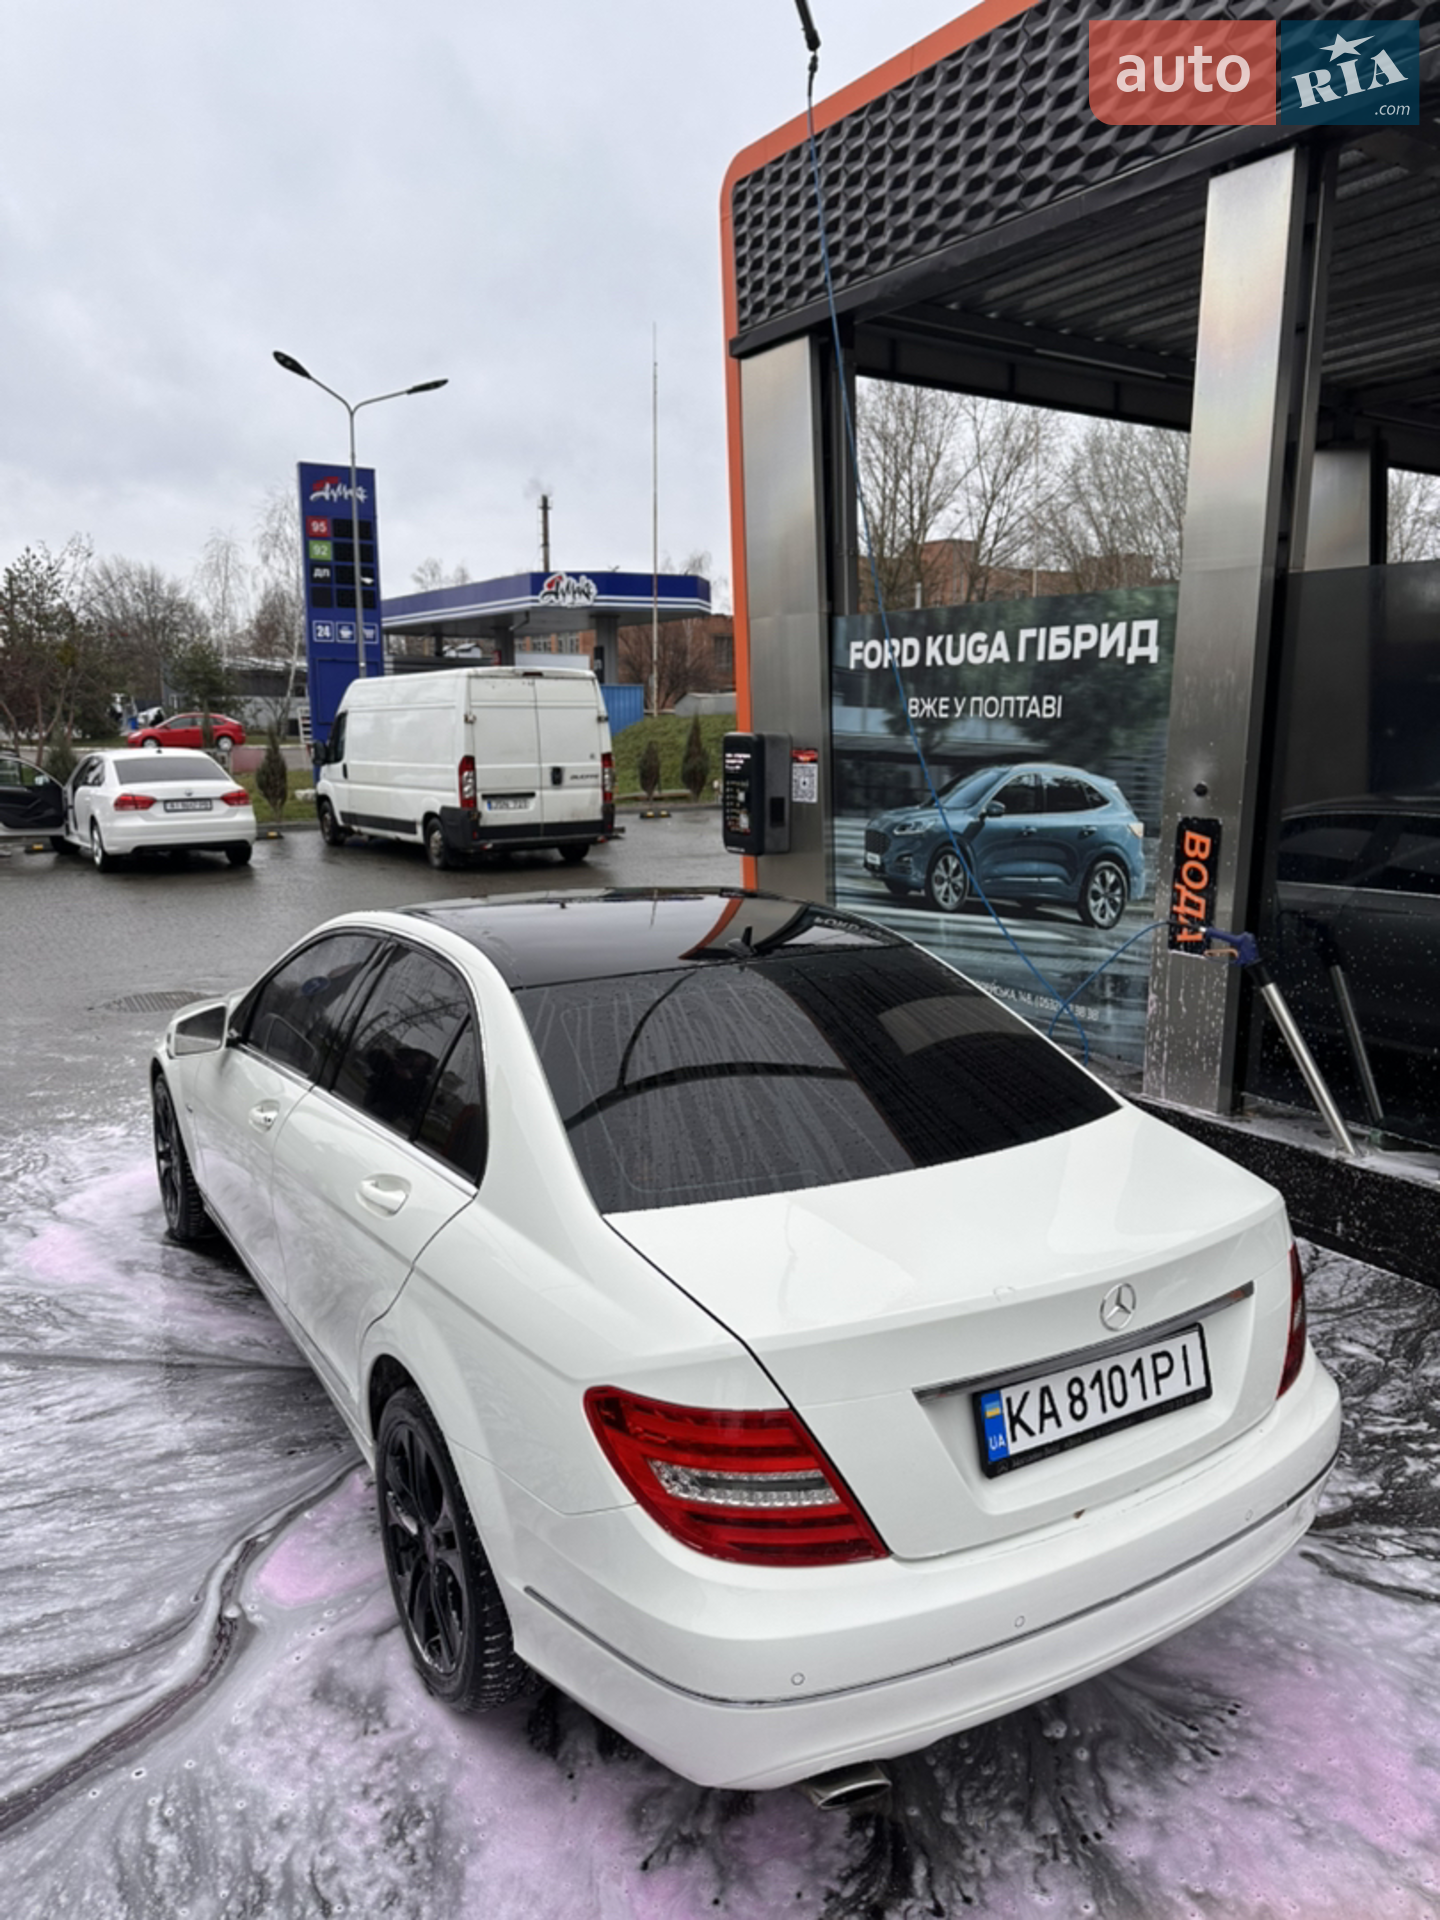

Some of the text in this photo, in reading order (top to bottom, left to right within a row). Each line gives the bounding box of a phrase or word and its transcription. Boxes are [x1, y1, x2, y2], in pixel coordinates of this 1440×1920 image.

[312, 522, 327, 533] 95
[313, 544, 328, 556] 92
[316, 625, 330, 639] 24
[1018, 619, 1159, 664] ГІБРИД
[849, 631, 1010, 669] FORD KUGA
[908, 695, 1062, 719] ВЖЕ У ПОЛТАВІ
[989, 1434, 1006, 1450] UA
